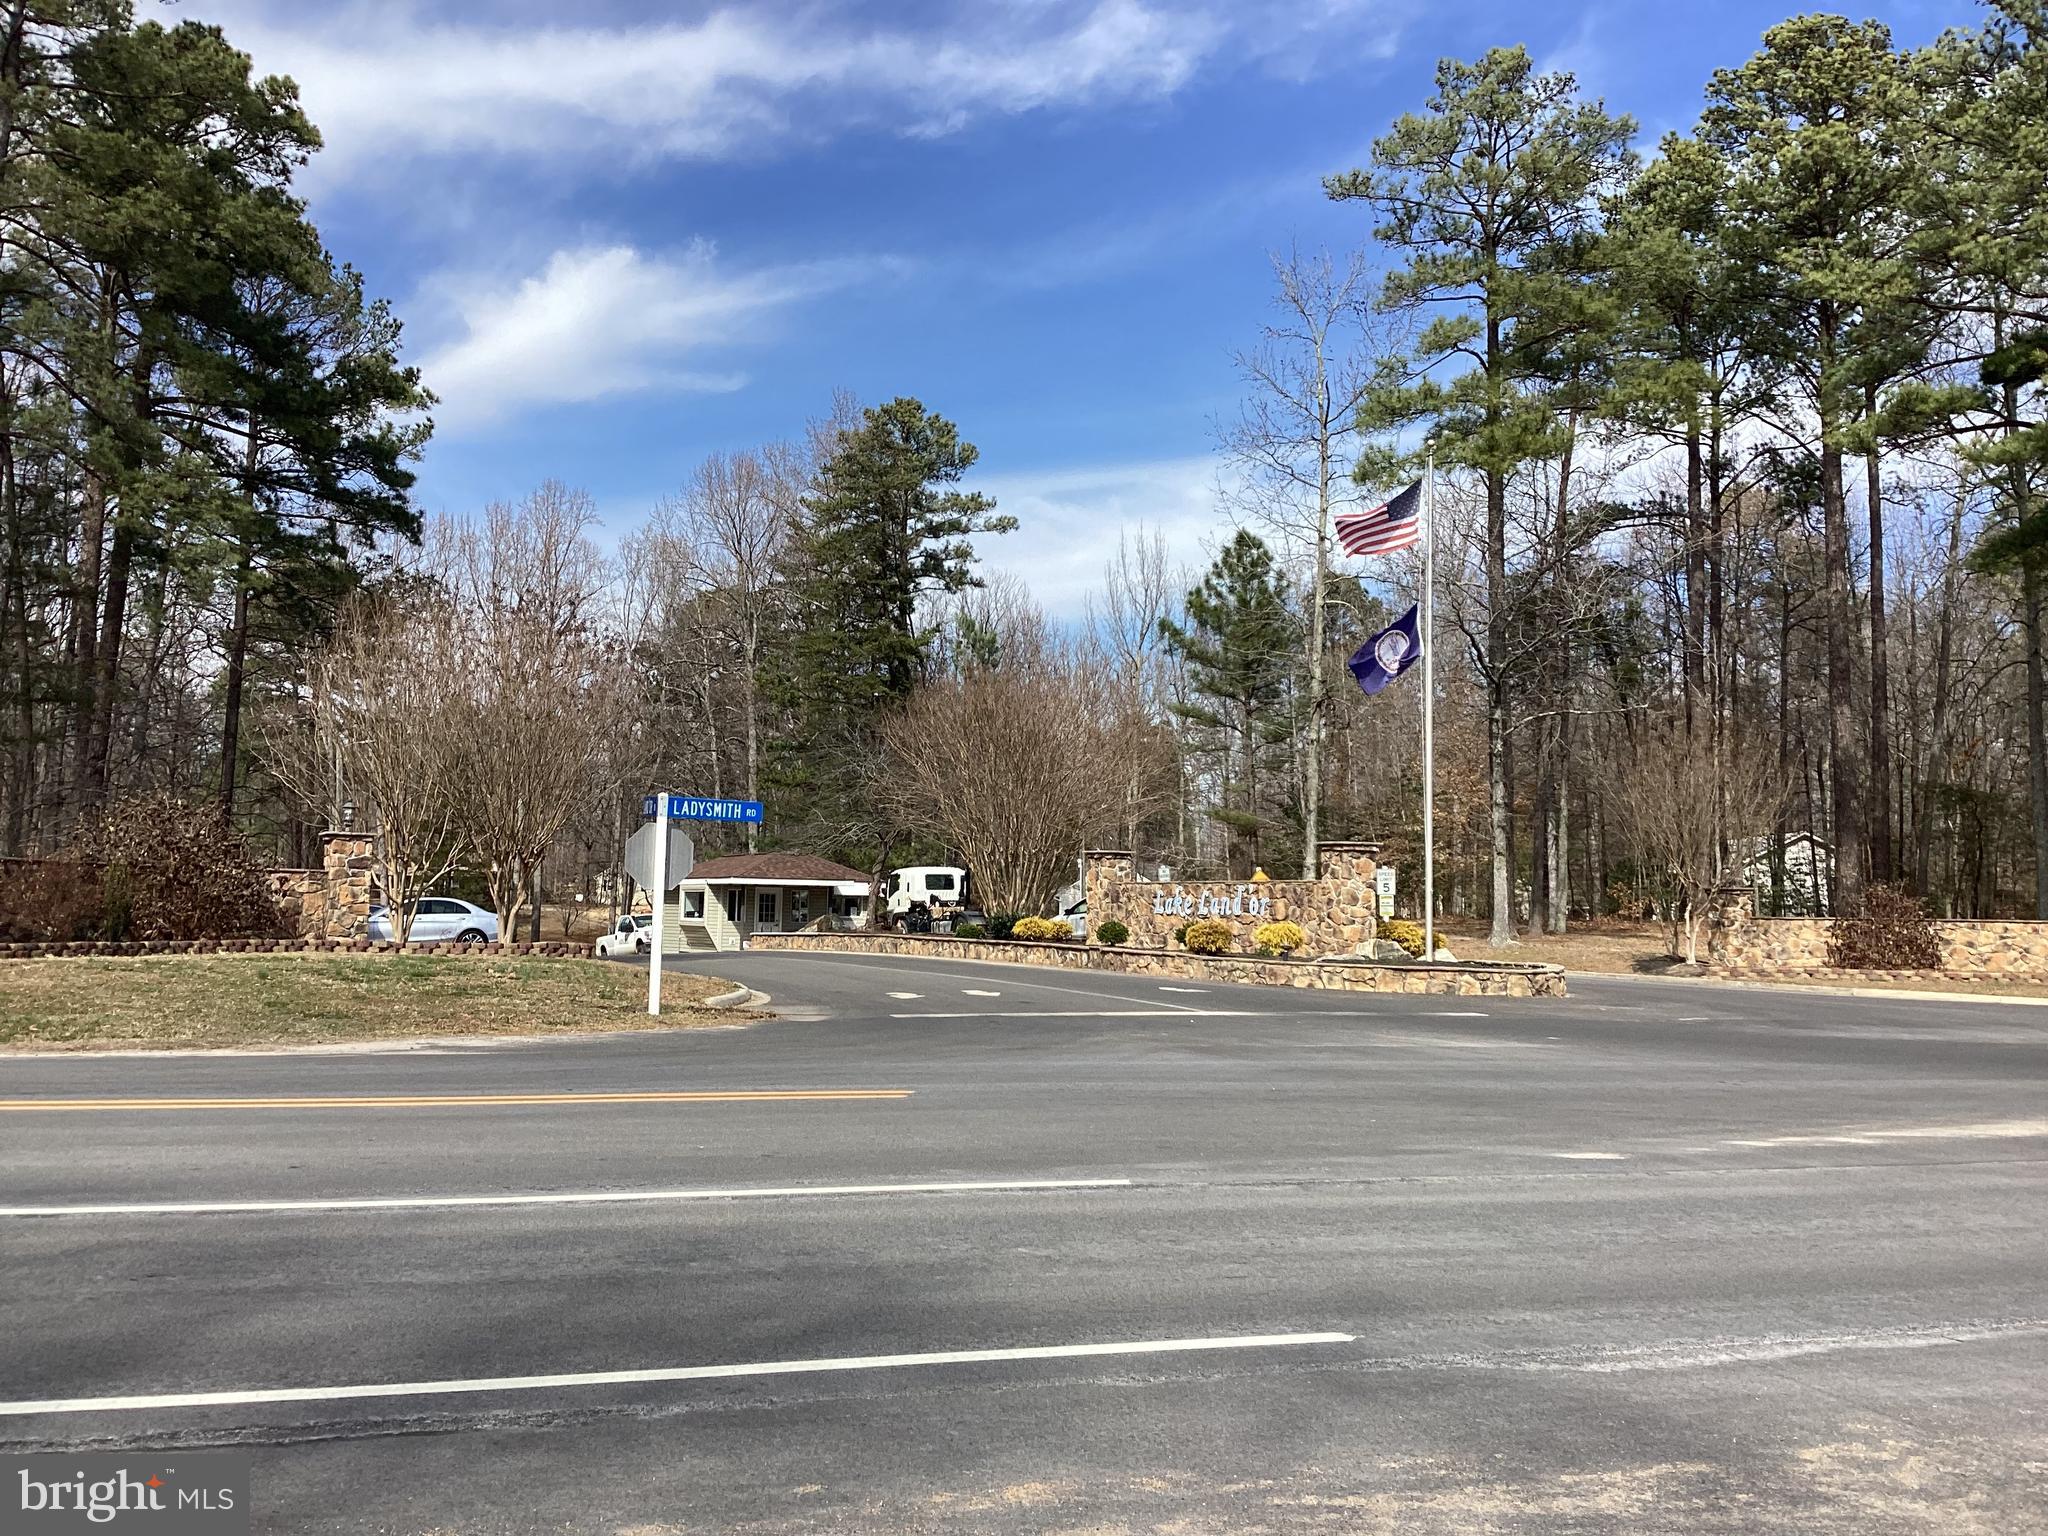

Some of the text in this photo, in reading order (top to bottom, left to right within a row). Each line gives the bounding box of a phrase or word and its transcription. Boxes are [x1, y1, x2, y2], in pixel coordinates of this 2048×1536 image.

[673, 800, 741, 819] LADYSMITH
[746, 809, 757, 817] RD
[1383, 883, 1390, 893] 5
[1153, 885, 1193, 917] Lake
